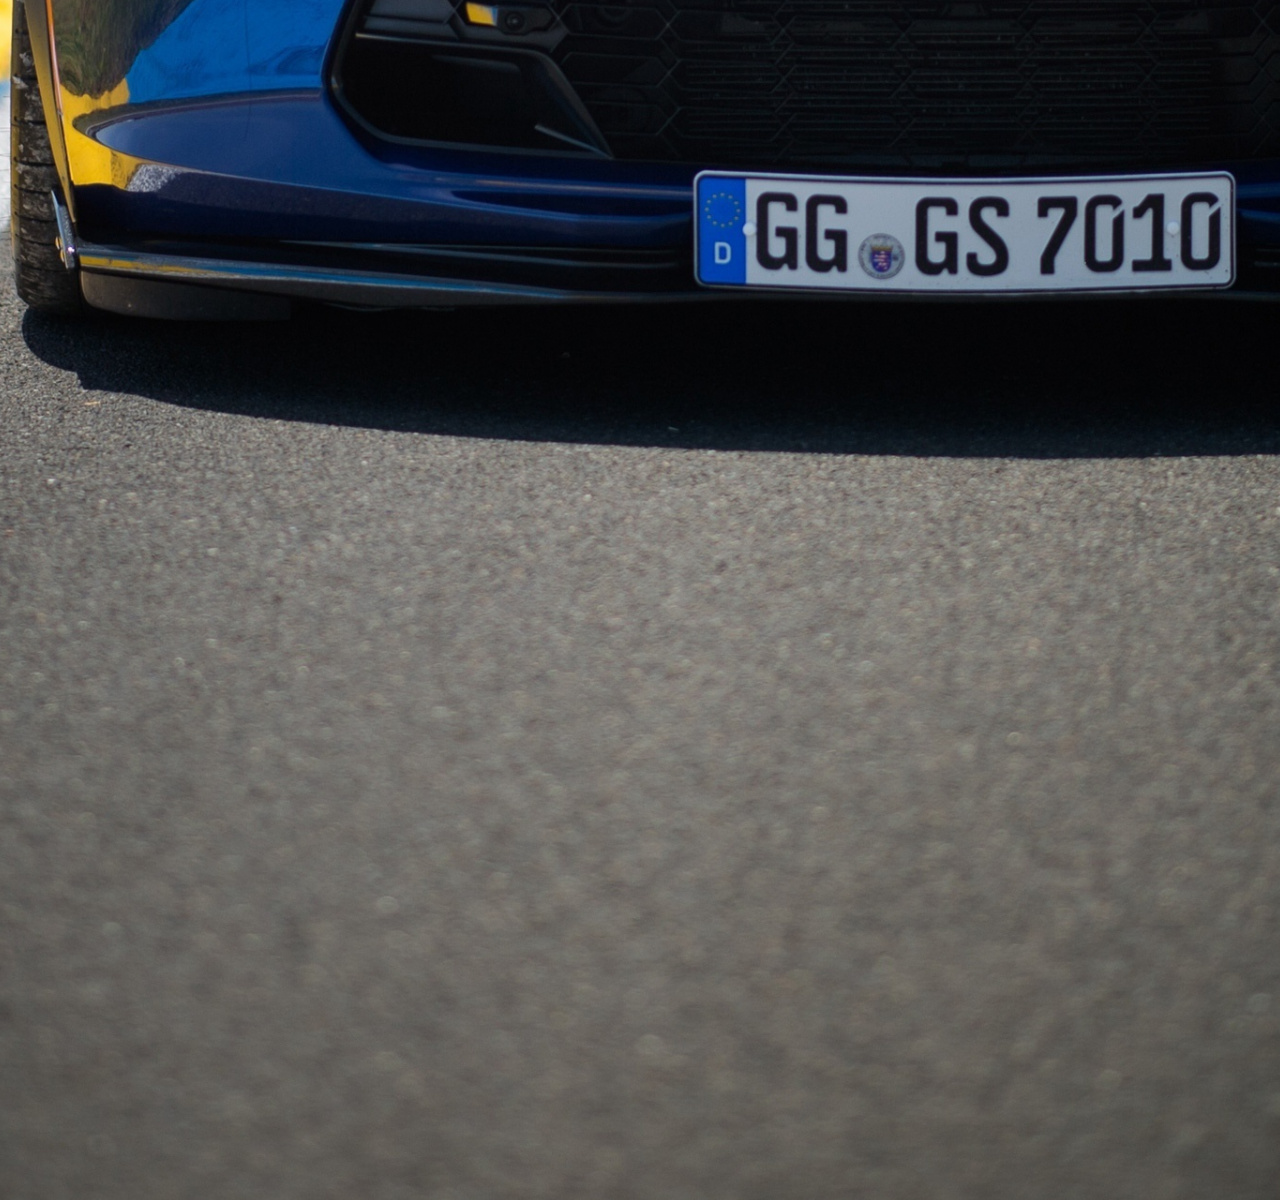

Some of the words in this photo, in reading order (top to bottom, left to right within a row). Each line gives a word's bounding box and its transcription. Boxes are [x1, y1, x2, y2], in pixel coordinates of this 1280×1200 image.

[714, 242, 731, 264] D
[755, 191, 848, 274] GG
[914, 196, 1010, 278] GS
[1036, 191, 1222, 276] 7010
